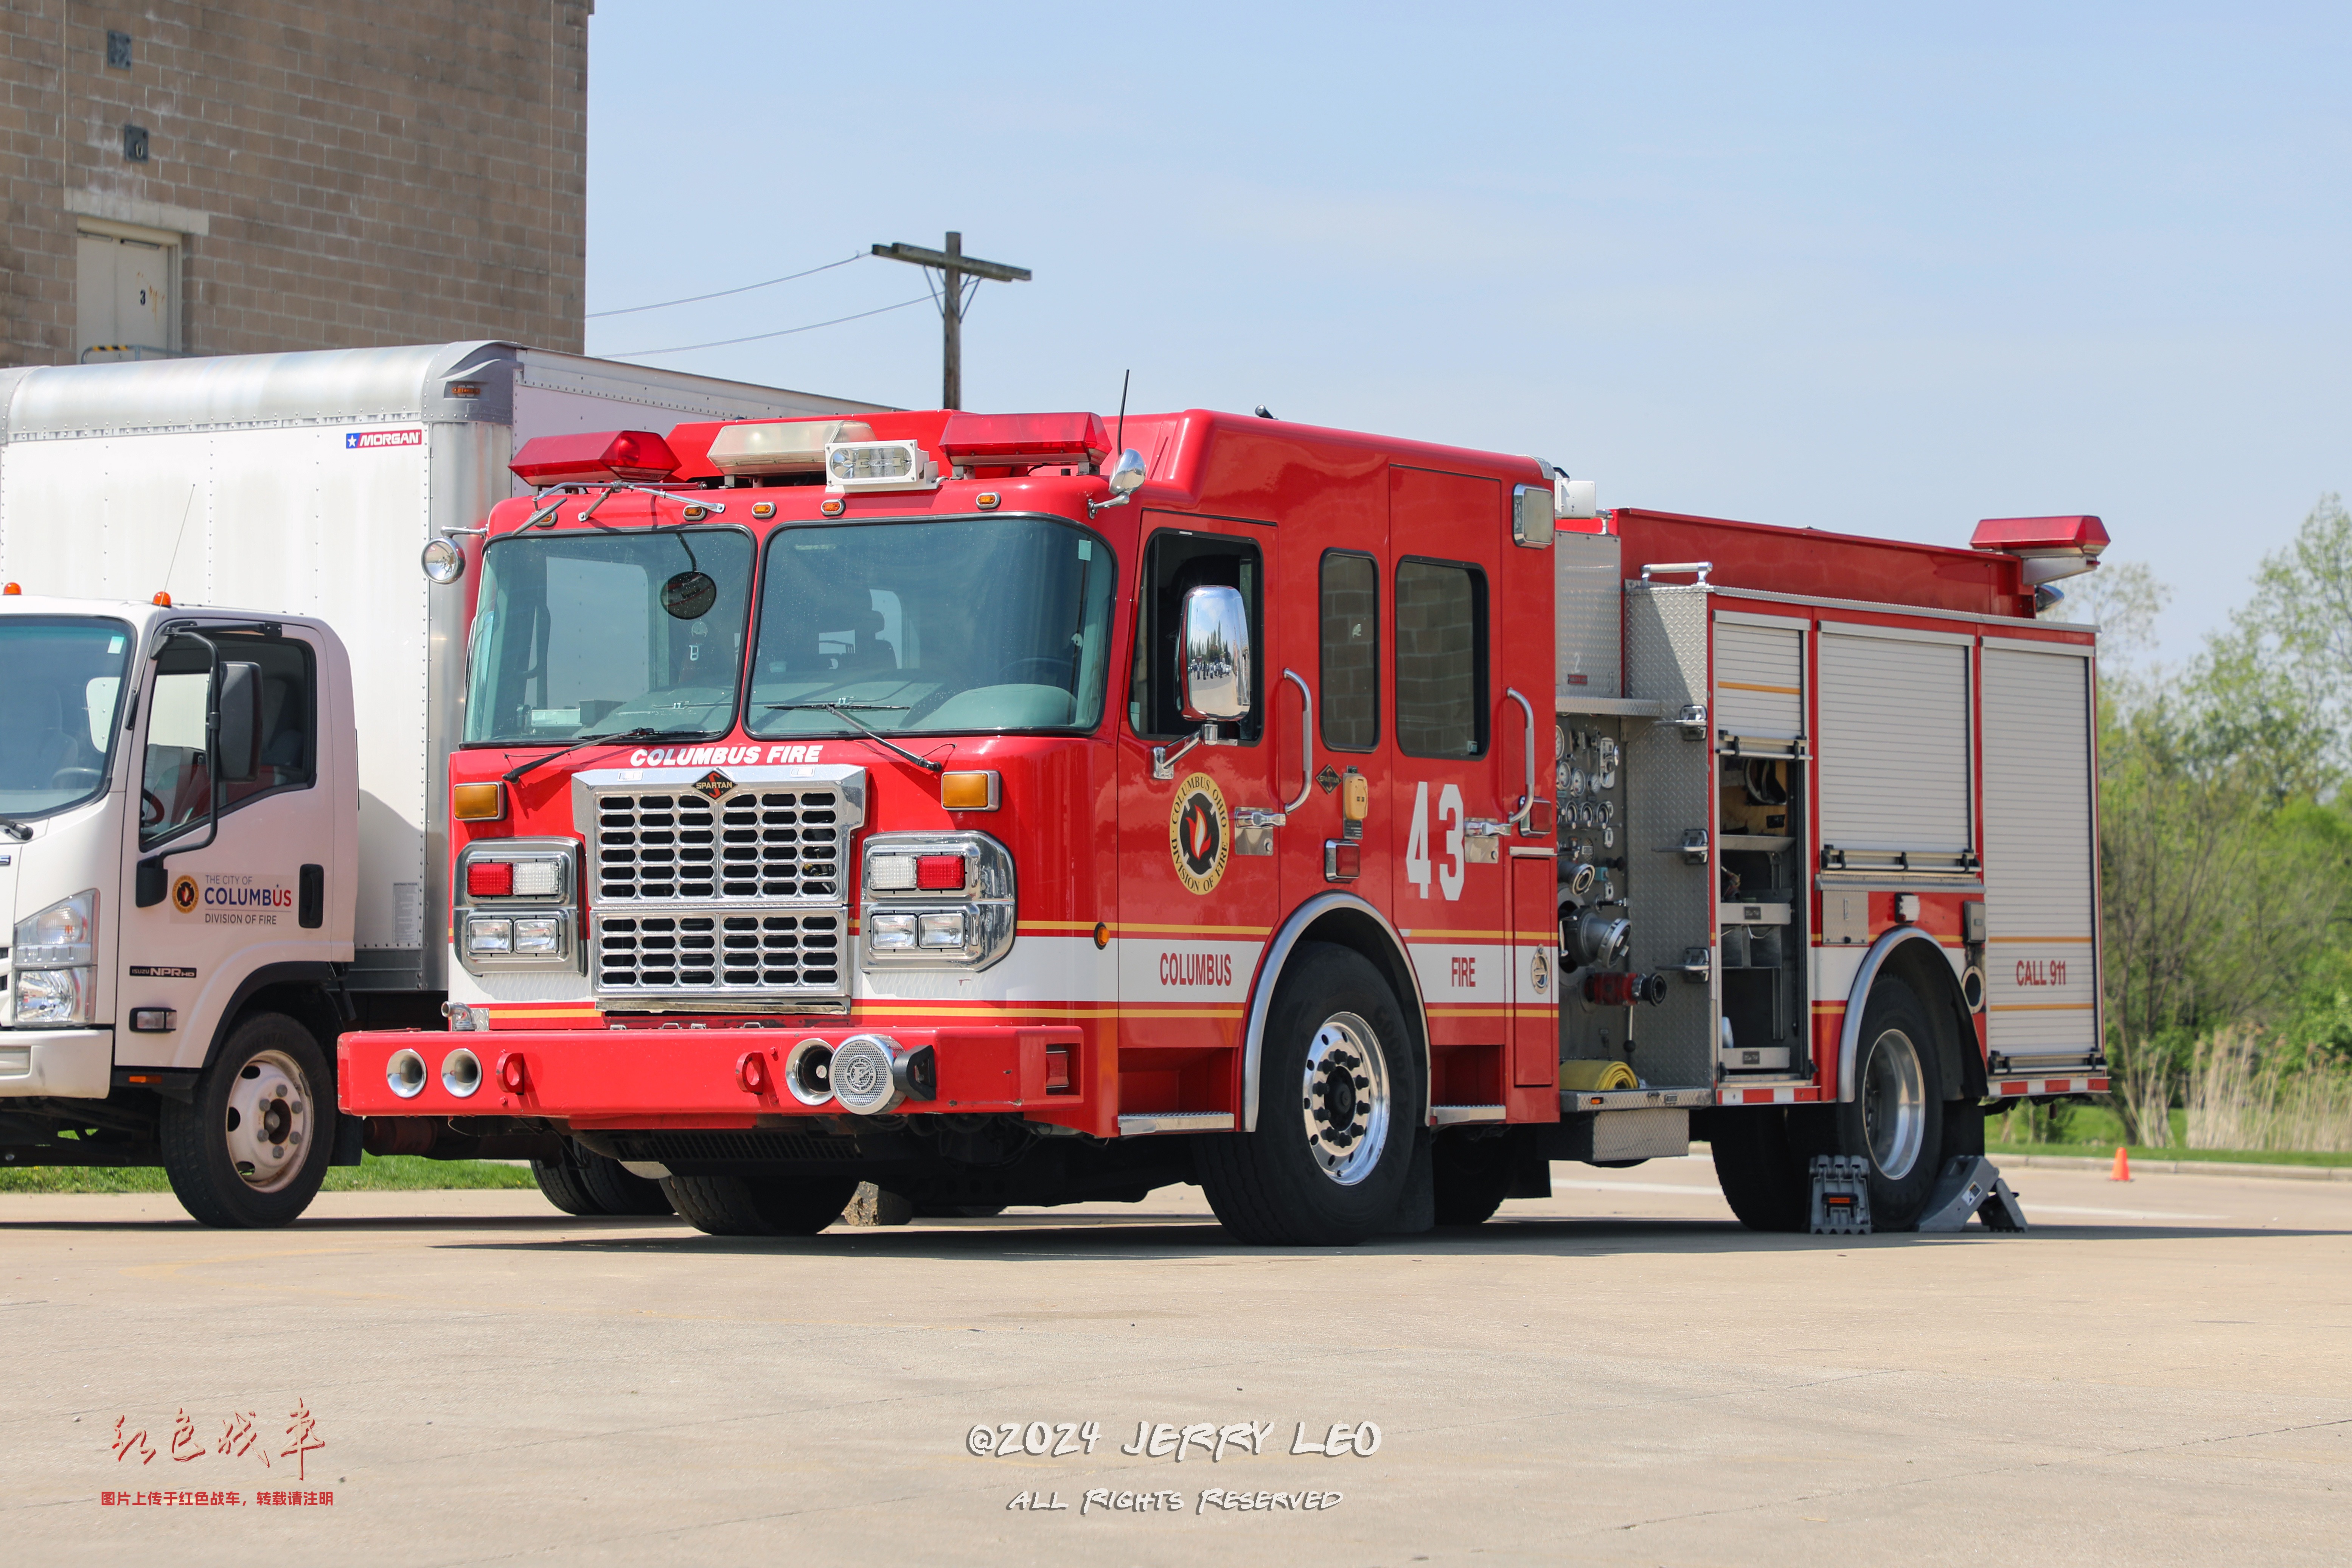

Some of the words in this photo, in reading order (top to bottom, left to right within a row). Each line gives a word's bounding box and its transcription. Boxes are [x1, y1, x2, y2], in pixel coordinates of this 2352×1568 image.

[140, 289, 146, 306] 3
[359, 432, 419, 447] MORGAN
[630, 746, 760, 767] COLUMBUS
[766, 745, 823, 763] FIRE
[1319, 775, 1340, 783] SPARTAN
[1172, 776, 1210, 825] COLUMBUS
[1213, 789, 1227, 828] OHIO
[1406, 781, 1464, 901] 43
[1171, 838, 1199, 892] DIVISION
[1203, 875, 1214, 892] OF
[1215, 841, 1228, 878] FIRE
[205, 875, 220, 884] THE
[222, 875, 239, 885] CITY
[242, 876, 252, 885] OF
[204, 887, 292, 907] COLUMBUS
[205, 913, 242, 924] DIVISION
[245, 914, 256, 924] OF
[259, 915, 277, 925] FIRE
[1160, 953, 1232, 987] COLUMBUS
[1451, 957, 1476, 987] FIRE
[2016, 960, 2047, 987] CALL
[2050, 960, 2066, 986] 911
